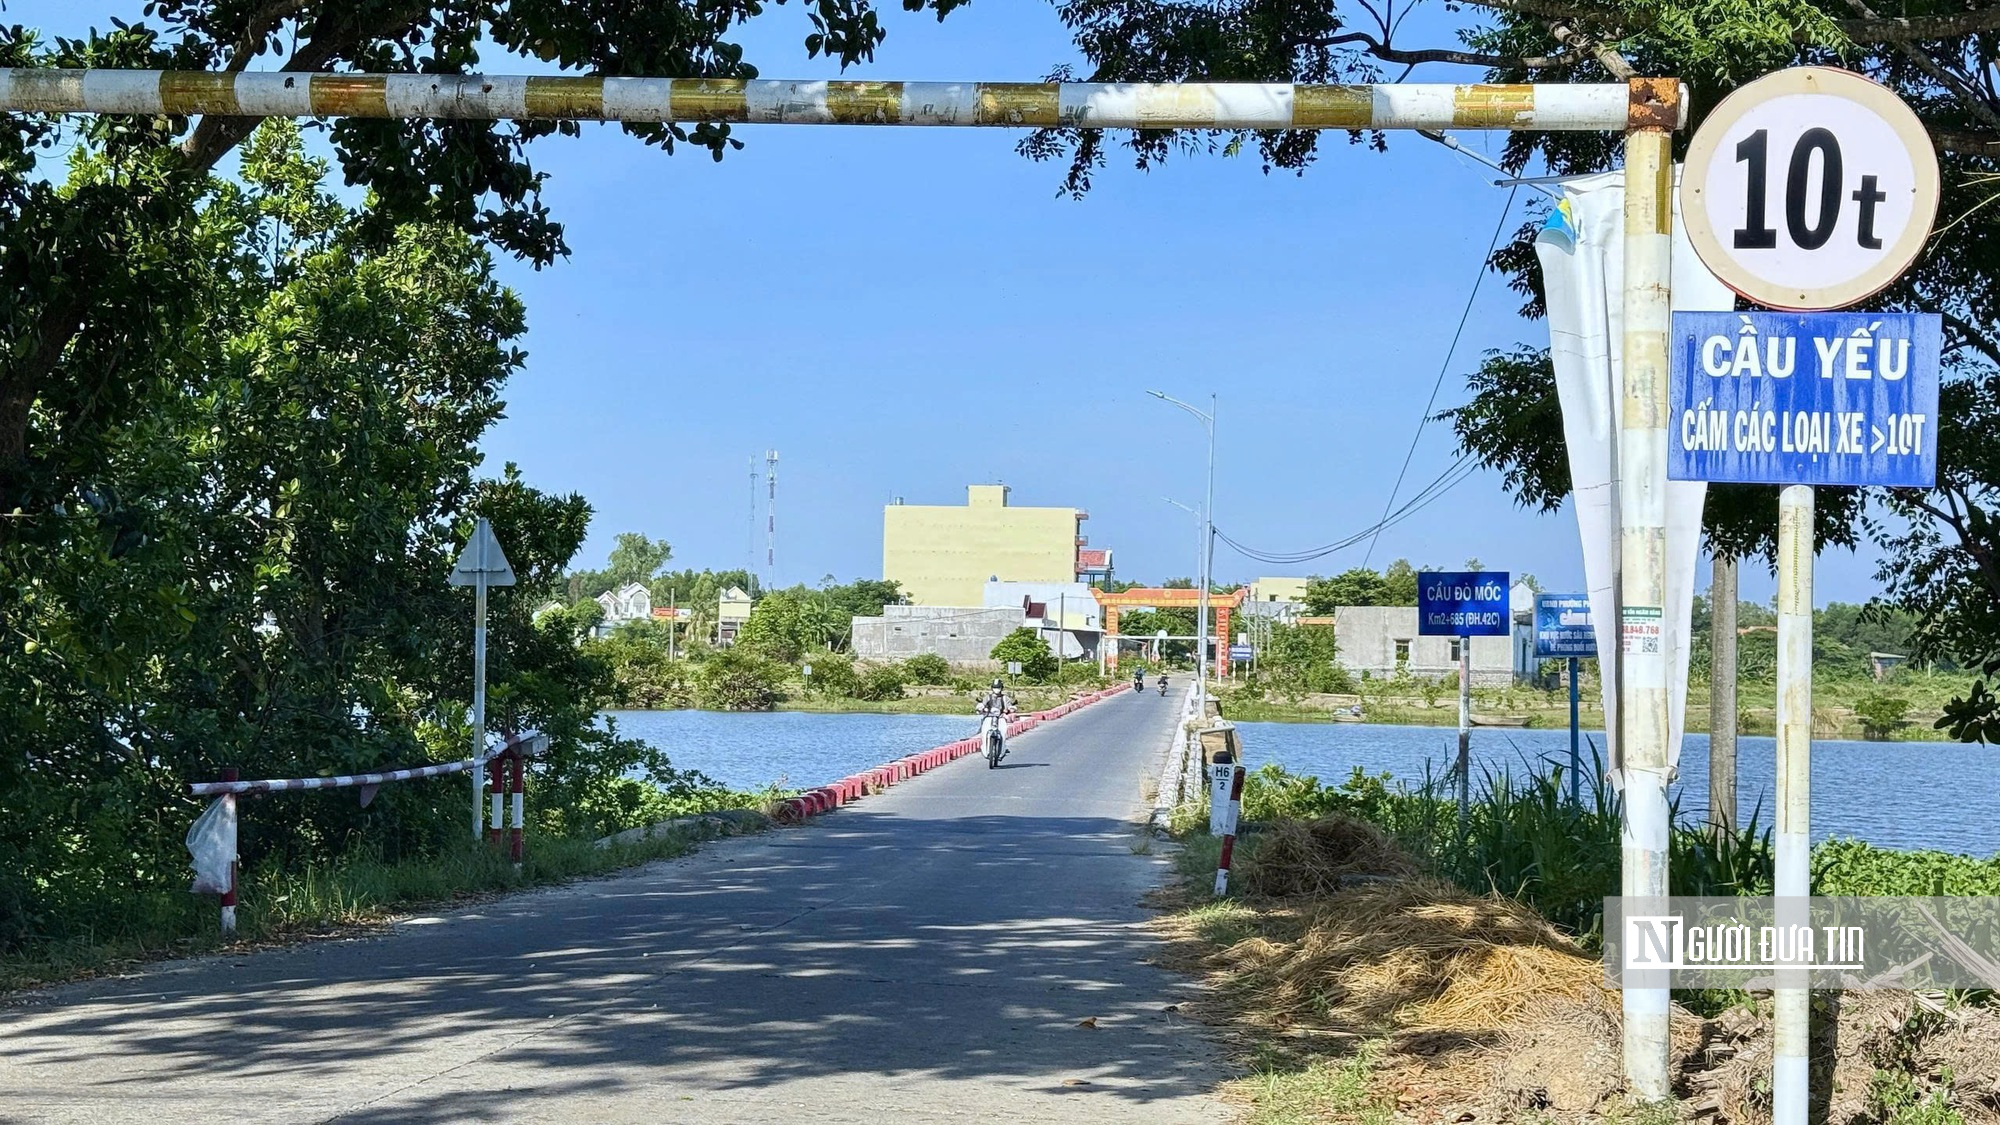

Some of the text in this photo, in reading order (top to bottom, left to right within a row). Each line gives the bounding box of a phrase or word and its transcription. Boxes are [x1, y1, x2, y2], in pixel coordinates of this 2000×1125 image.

[1733, 127, 1887, 250] 10t
[1702, 314, 1911, 381] CẦU YẾU
[1681, 397, 1728, 453] CẤM
[1734, 402, 1776, 455] CÁC
[1781, 409, 1831, 463] LOẠI
[1836, 413, 1863, 455] XE
[1427, 580, 1502, 602] CẦU ĐÒ MỐC
[1216, 766, 1230, 777] H6
[1219, 781, 1225, 790] 2
